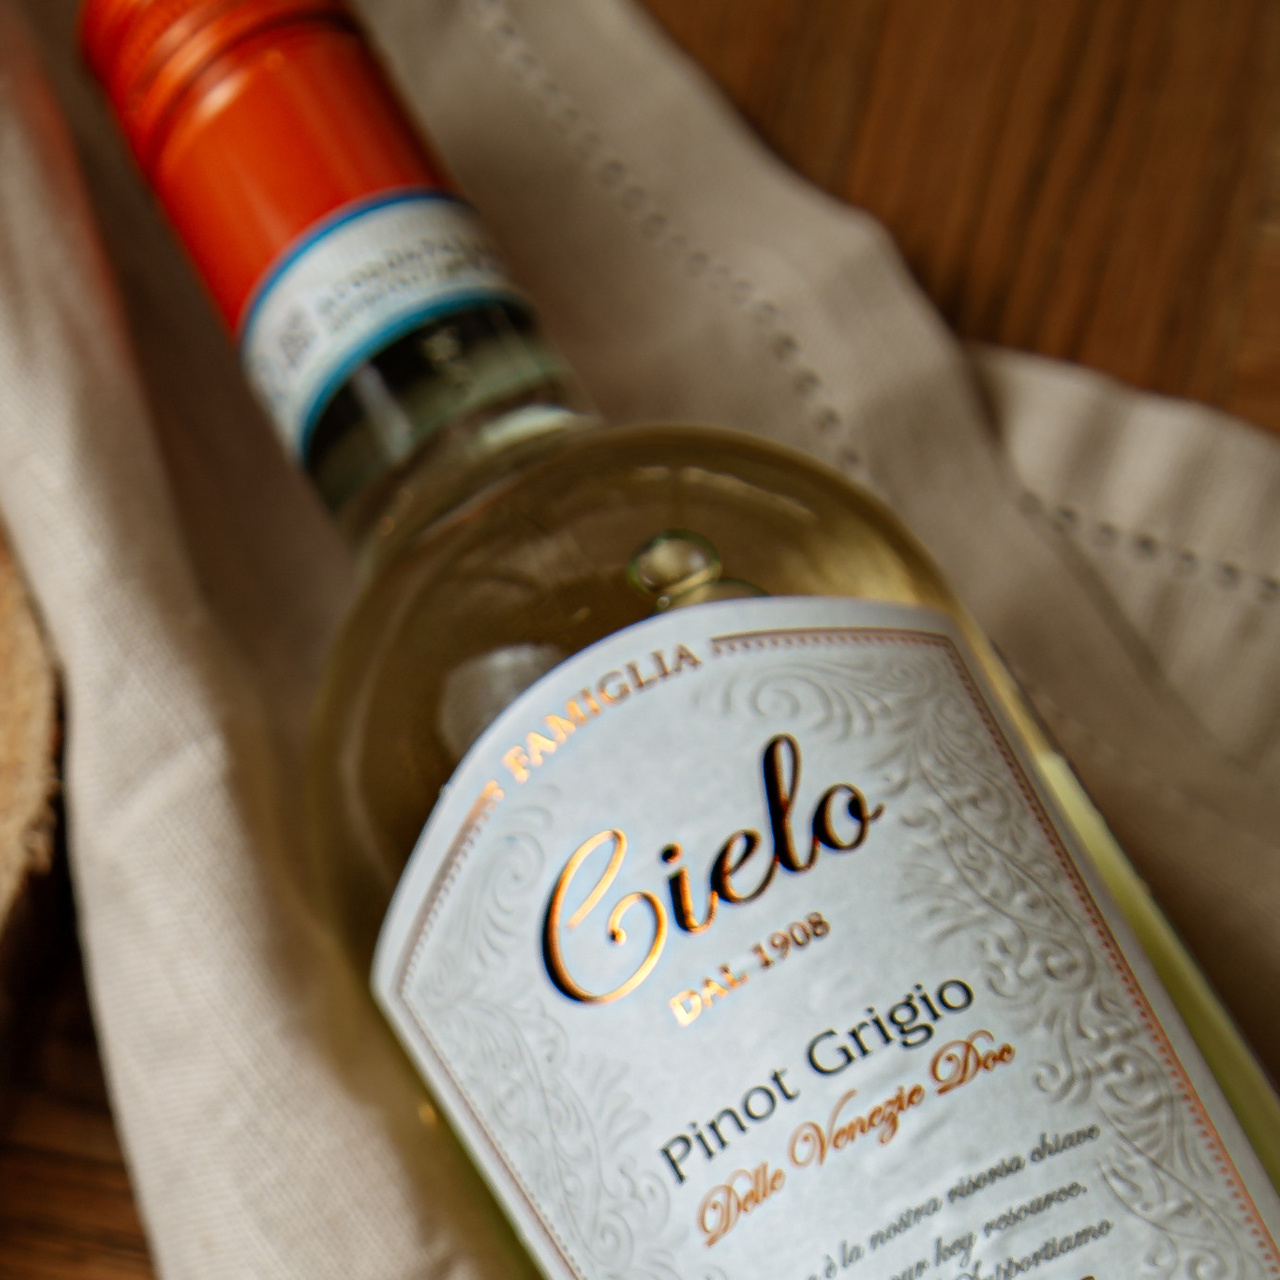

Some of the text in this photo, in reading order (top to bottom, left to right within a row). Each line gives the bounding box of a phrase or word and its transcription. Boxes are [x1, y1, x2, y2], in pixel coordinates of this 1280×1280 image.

[501, 643, 702, 784] FAMIGLIA
[540, 732, 885, 1004] Cielo
[669, 911, 830, 1027] DAL 1908
[660, 978, 974, 1185] Pinot Grigio
[697, 1029, 1016, 1247] Delle Venezie Doc
[839, 1239, 864, 1269] la
[869, 1196, 942, 1250] nostra
[947, 1155, 1026, 1202] risorsa
[1030, 1123, 1101, 1164] chiave
[934, 1231, 977, 1267] key
